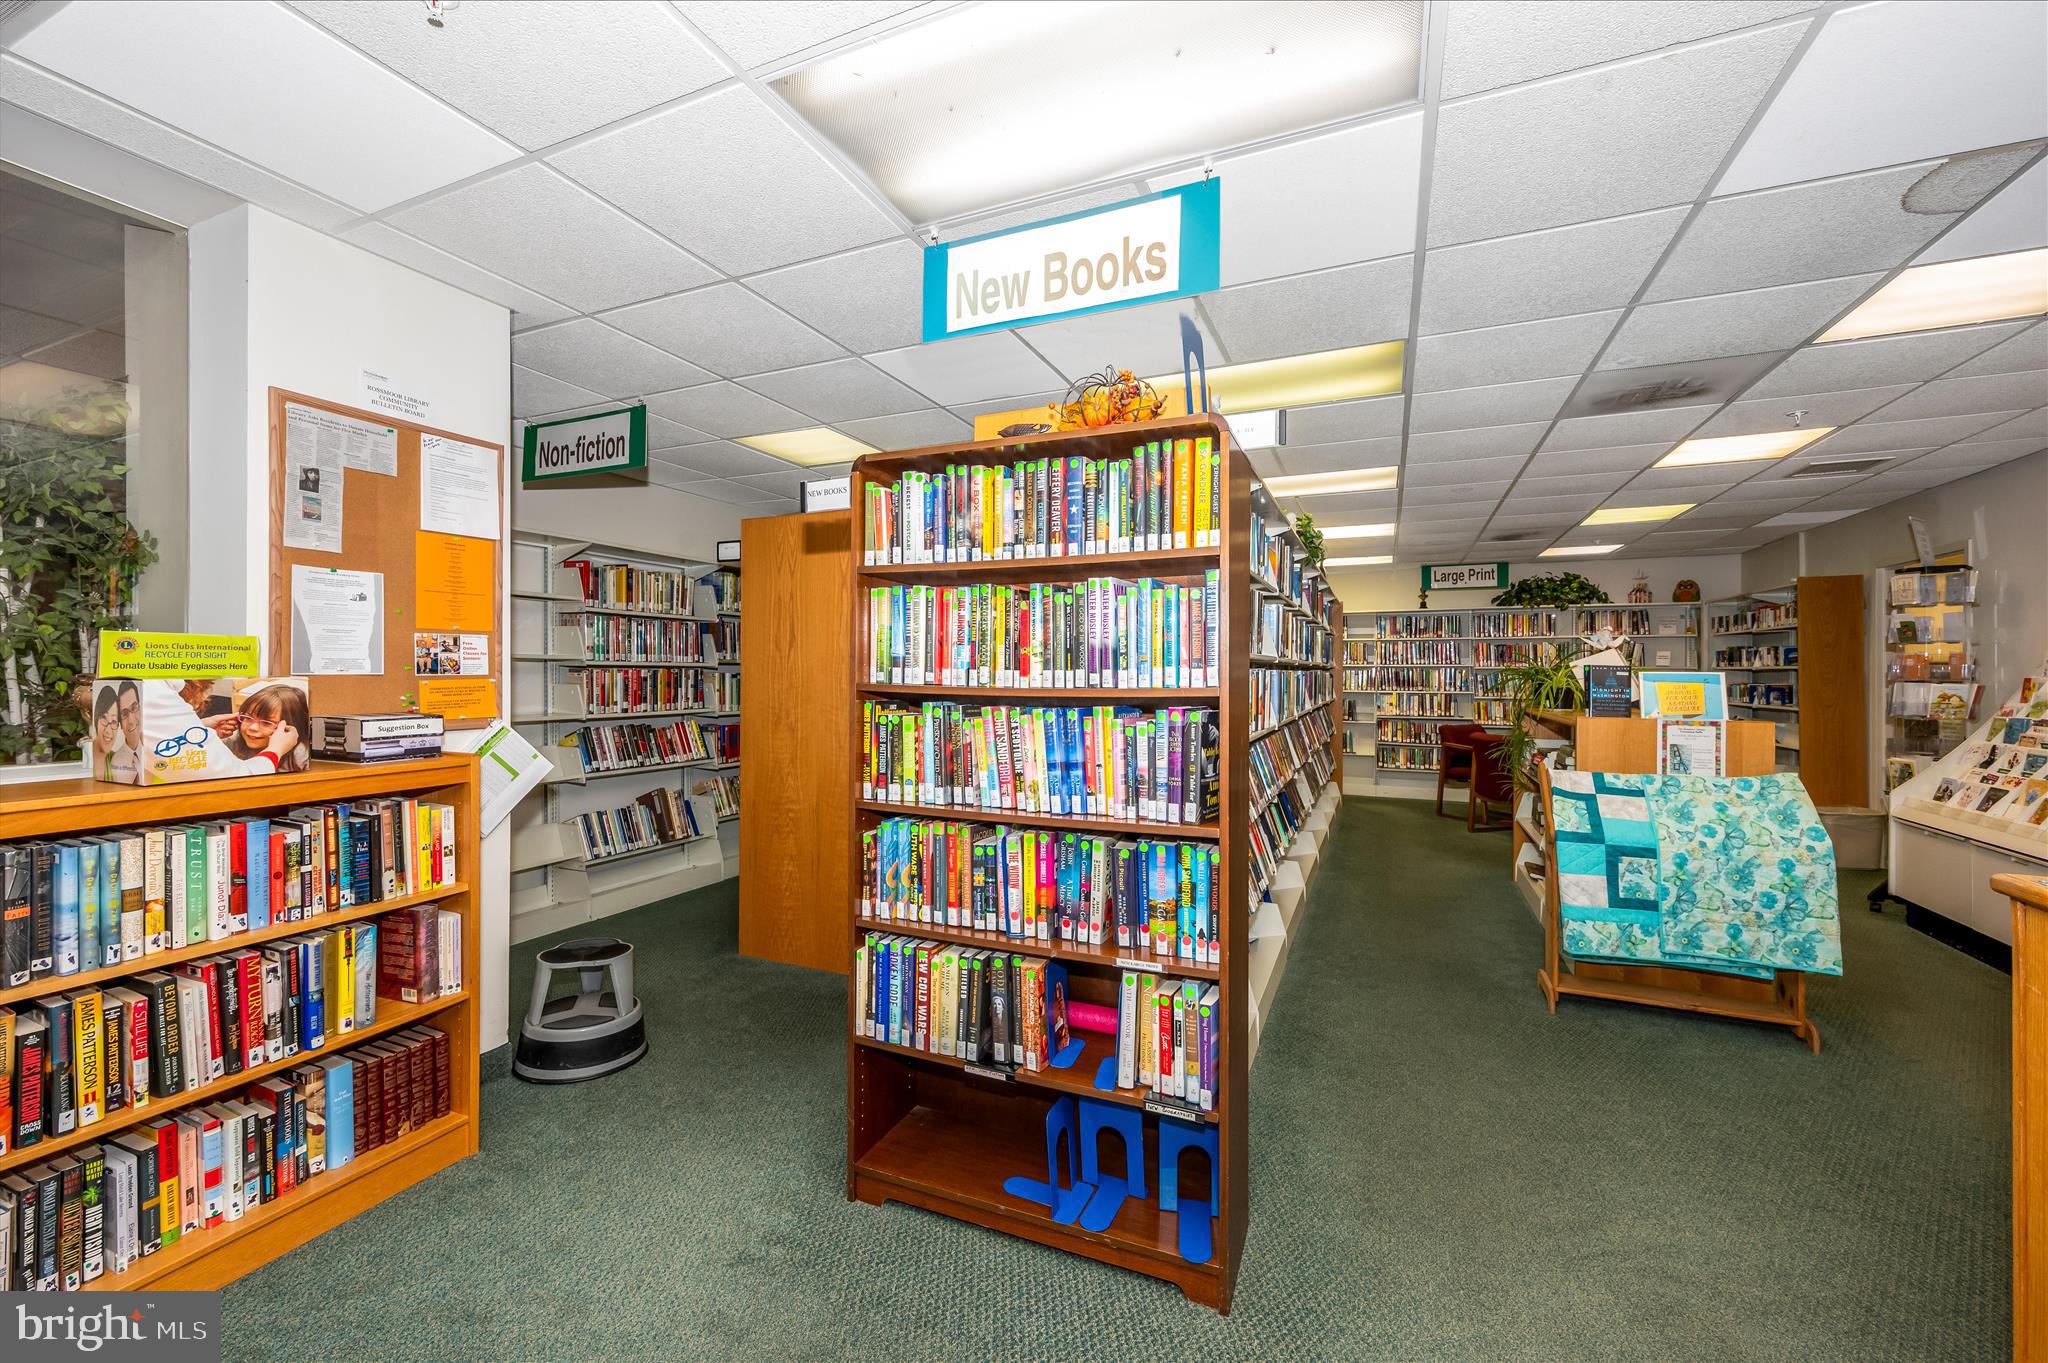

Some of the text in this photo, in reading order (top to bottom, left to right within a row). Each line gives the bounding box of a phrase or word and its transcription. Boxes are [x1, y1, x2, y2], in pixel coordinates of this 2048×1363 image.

[956, 236, 1166, 319] New Books
[367, 384, 430, 407] ROSSMOOR LIBRARY
[371, 399, 426, 419] BULLETIN BOARD
[378, 394, 419, 410] COMMUNITY
[538, 431, 625, 468] Non-fiction
[807, 486, 848, 498] NEW BOOKS
[1199, 463, 1207, 504] GARDNER
[1051, 500, 1060, 533] DEAVER
[1434, 568, 1495, 584] Large Print
[957, 612, 966, 646] JOHNSON
[1078, 624, 1085, 634] OF
[1089, 612, 1097, 640] MOSLEY
[1102, 611, 1110, 640] MOSLEY
[1192, 601, 1202, 659] JAMES PATTERSON
[144, 650, 227, 659] RECYCLE FOR SIGHT
[145, 642, 251, 652] Lions Clubs International
[112, 661, 248, 672] Donate Usable Eyeglasses Here
[378, 722, 429, 733] Suggestion Box
[863, 722, 871, 754] PATTERSON
[933, 751, 941, 773] CHILD
[996, 736, 1011, 783] SANDFORD
[1011, 728, 1024, 775] SCOTTOLINE
[148, 837, 163, 857] Jude
[190, 836, 202, 891] TRUST
[1009, 851, 1020, 889] THE WIDOW
[216, 880, 226, 904] Junot
[1181, 869, 1191, 907] SANDFORD
[1156, 899, 1167, 935] LEGACY
[247, 959, 262, 1021] MY TURN
[890, 983, 898, 1007] CODE
[918, 976, 928, 1002] COLD
[164, 984, 179, 1055] BEYOND ORDER
[918, 1005, 927, 1035] WARS
[1143, 985, 1151, 1029] NOUGH
[135, 1010, 147, 1055] STILL LIFE
[250, 1020, 259, 1048] REAGAN
[1125, 1012, 1133, 1039] HONOR
[80, 998, 98, 1090] JAMES PATTERSON
[106, 1019, 119, 1084] JAMES PATTERSON
[20, 1046, 41, 1124] JAMES PATTERSON
[283, 1092, 291, 1118] STUART
[1147, 1103, 1158, 1111] NEW
[232, 1120, 240, 1146] Happiness
[43, 1183, 56, 1213] DONALD
[85, 1203, 103, 1233] NIGHT
[23, 1206, 36, 1267] DONALD WESTLAKE
[63, 1199, 80, 1272] HUNTER'S MOON
